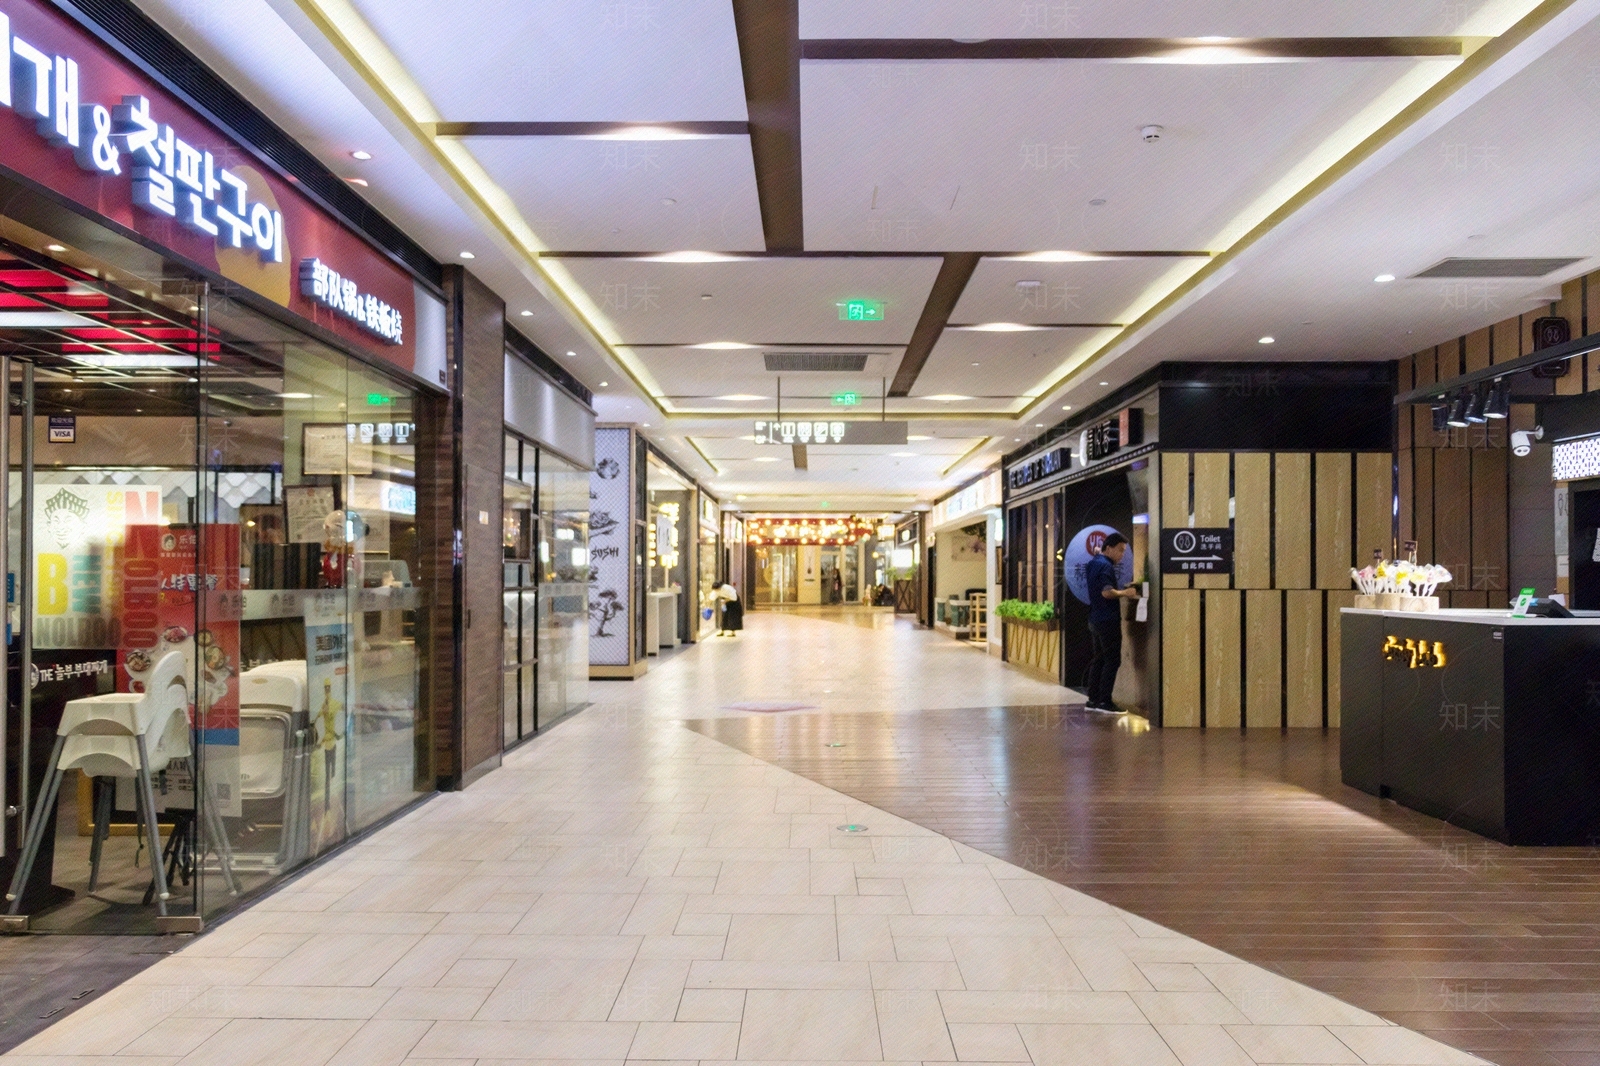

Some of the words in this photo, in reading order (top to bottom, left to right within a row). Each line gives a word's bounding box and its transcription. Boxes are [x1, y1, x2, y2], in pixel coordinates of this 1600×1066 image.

[92, 105, 122, 176] &
[126, 94, 283, 263] 철판구이
[1200, 534, 1221, 543] Toilet
[1200, 543, 1222, 551] 洗手间
[590, 546, 619, 561] SUSHI
[1181, 562, 1214, 570] 由此向前
[35, 617, 123, 648] NOLBOO
